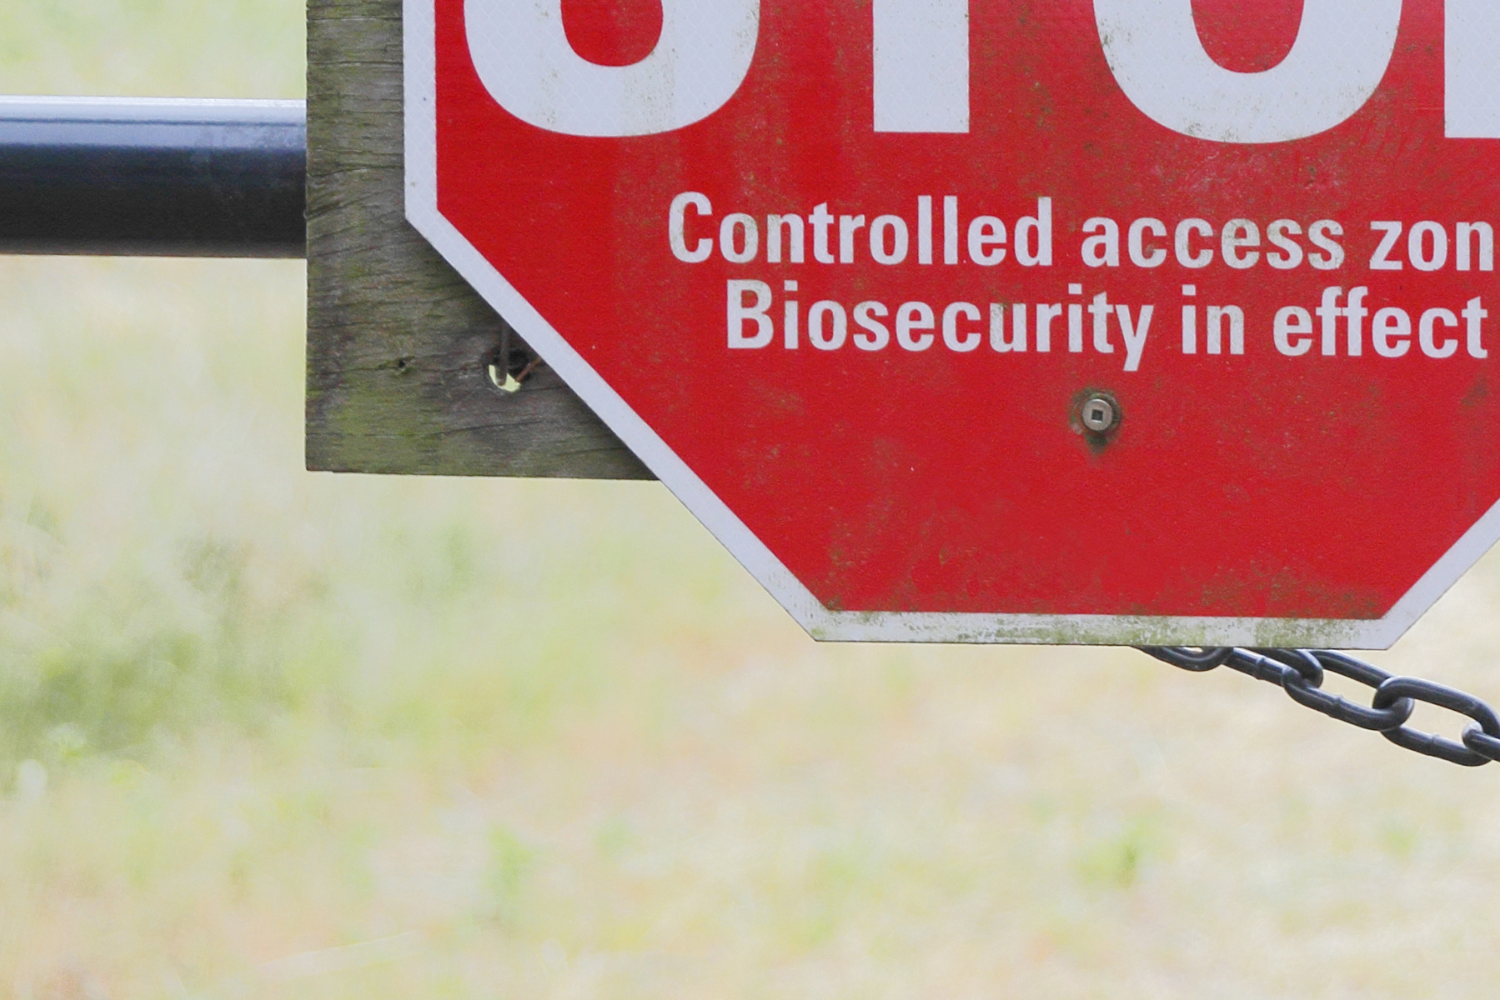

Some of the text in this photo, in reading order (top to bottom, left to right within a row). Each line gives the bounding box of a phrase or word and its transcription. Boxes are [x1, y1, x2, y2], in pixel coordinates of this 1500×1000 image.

[668, 191, 1053, 267] Controlled
[1080, 216, 1346, 271] access
[726, 278, 1488, 372] Biosecurity in effect
